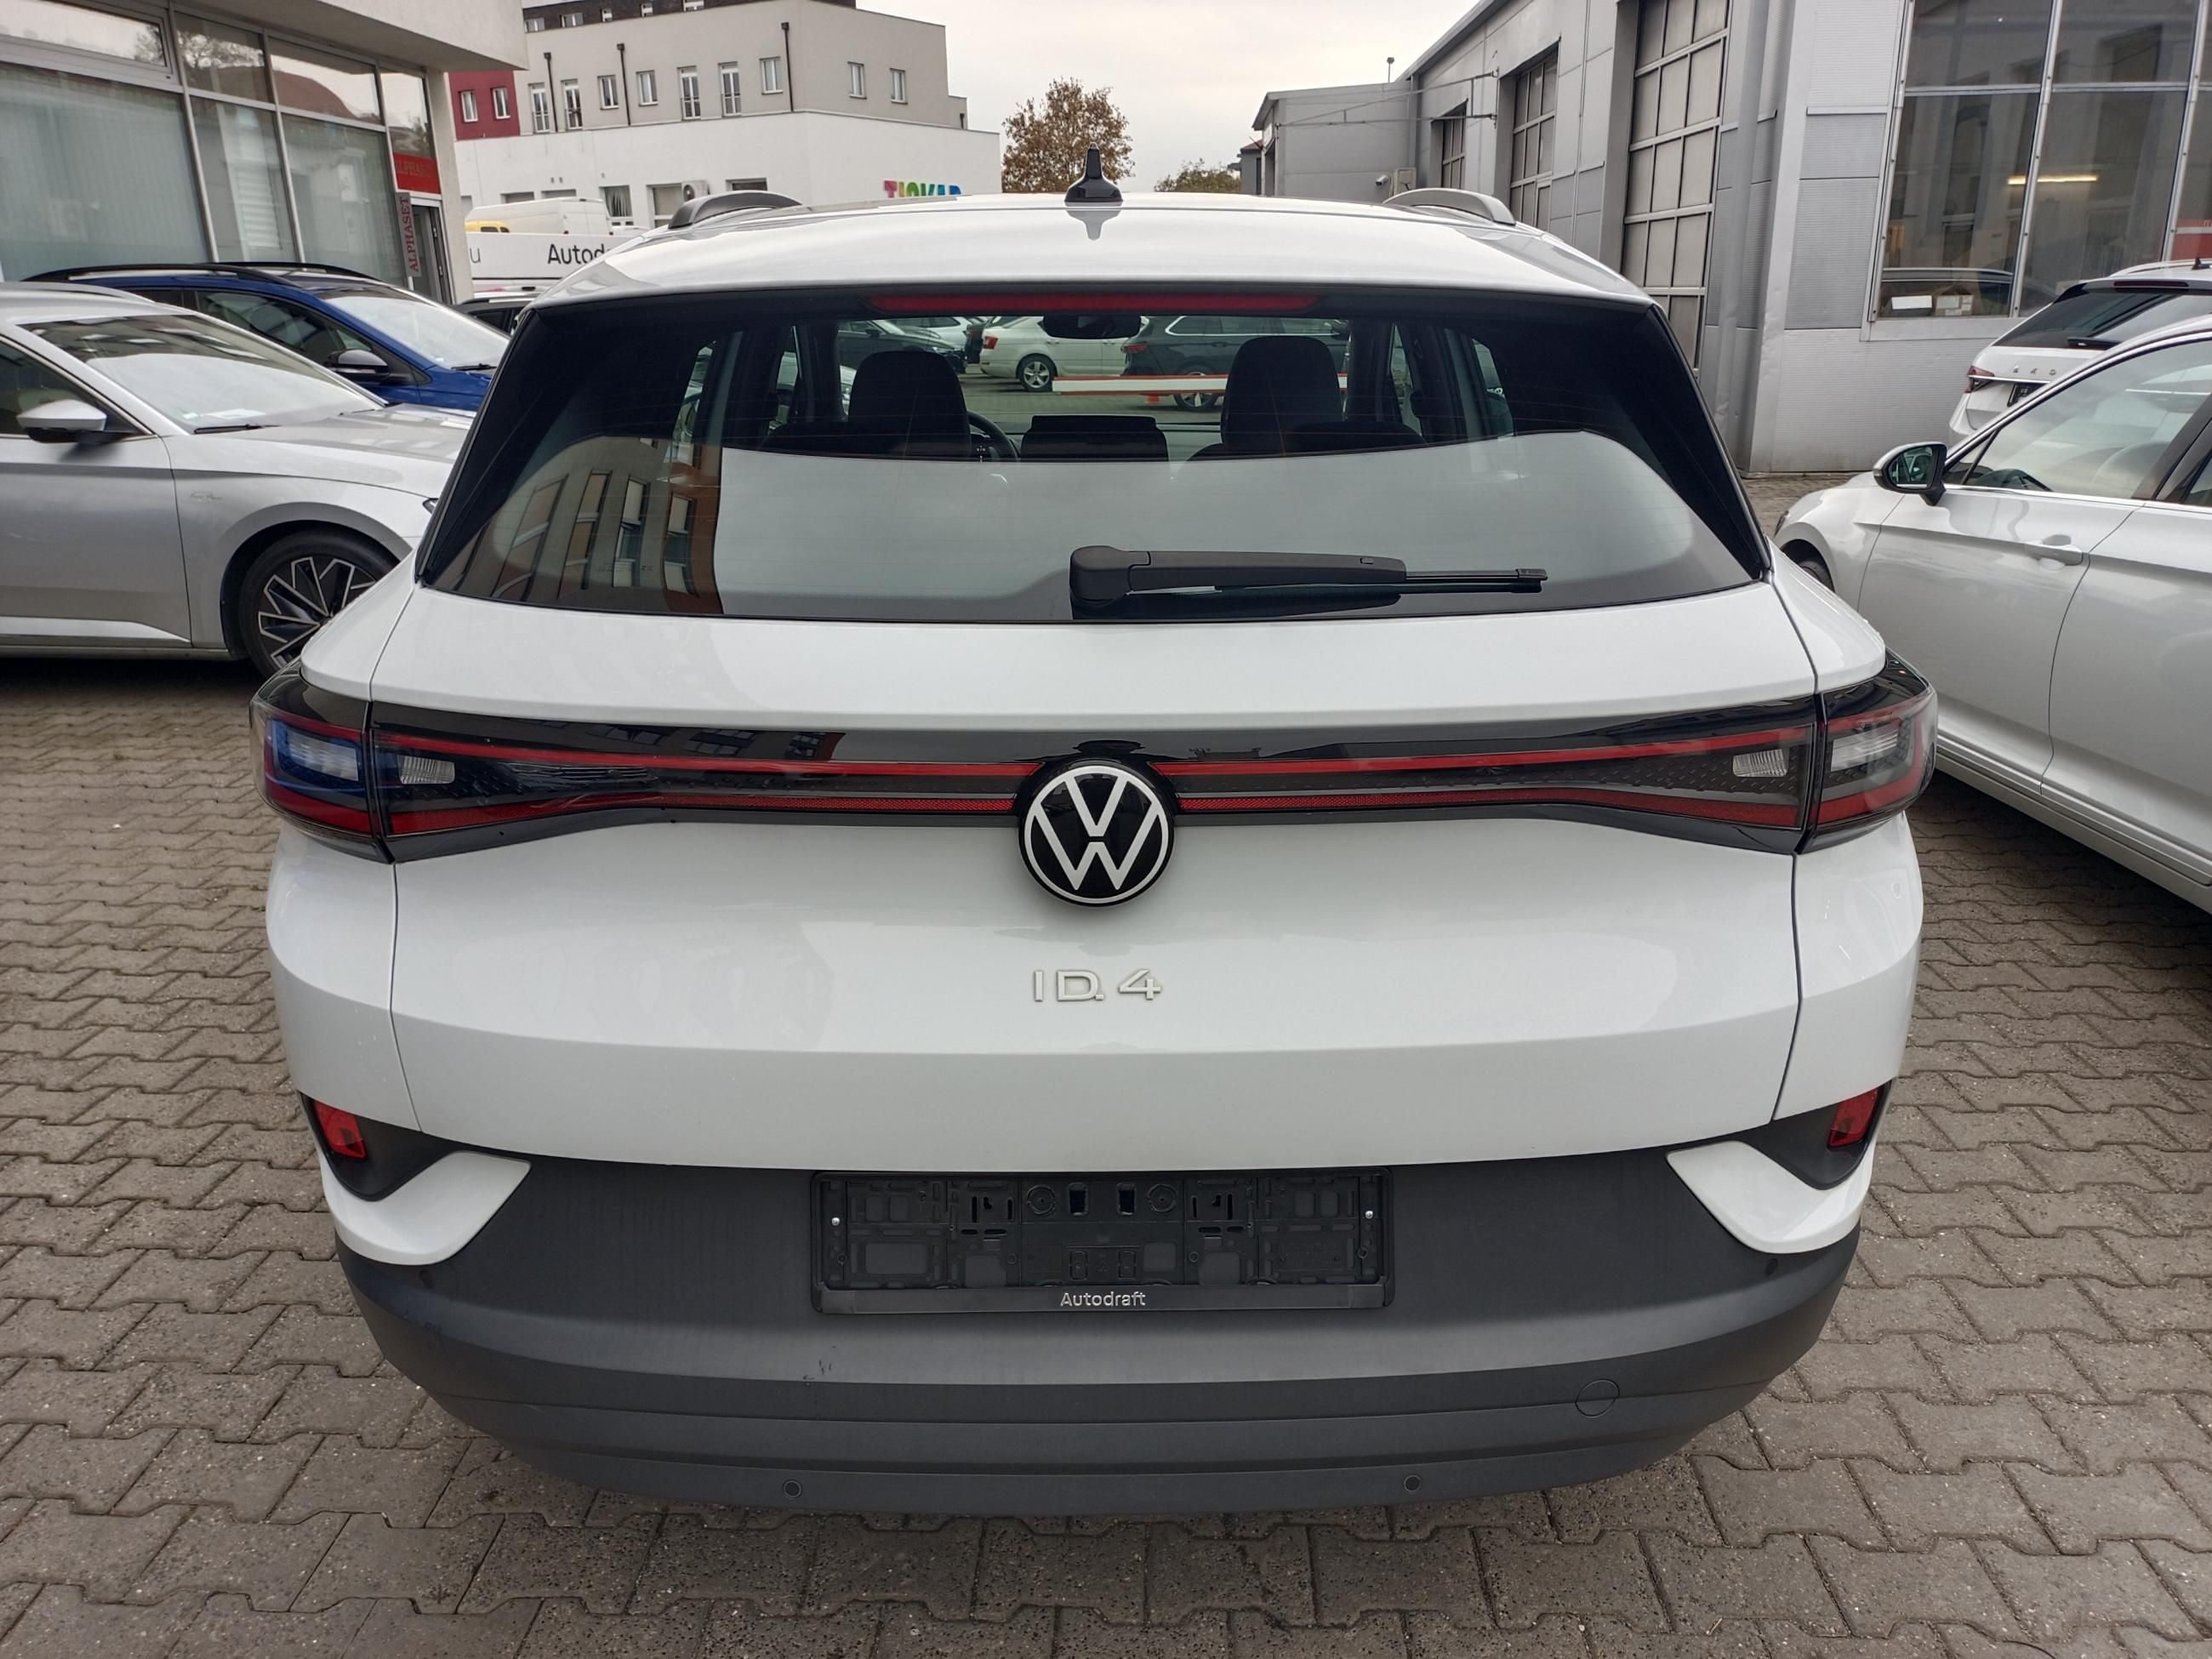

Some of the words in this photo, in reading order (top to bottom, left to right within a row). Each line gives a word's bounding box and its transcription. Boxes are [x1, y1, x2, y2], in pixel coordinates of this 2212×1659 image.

[399, 194, 419, 272] ALPHASET
[547, 243, 612, 265] Autod
[1060, 1291, 1146, 1307] Autodraft
